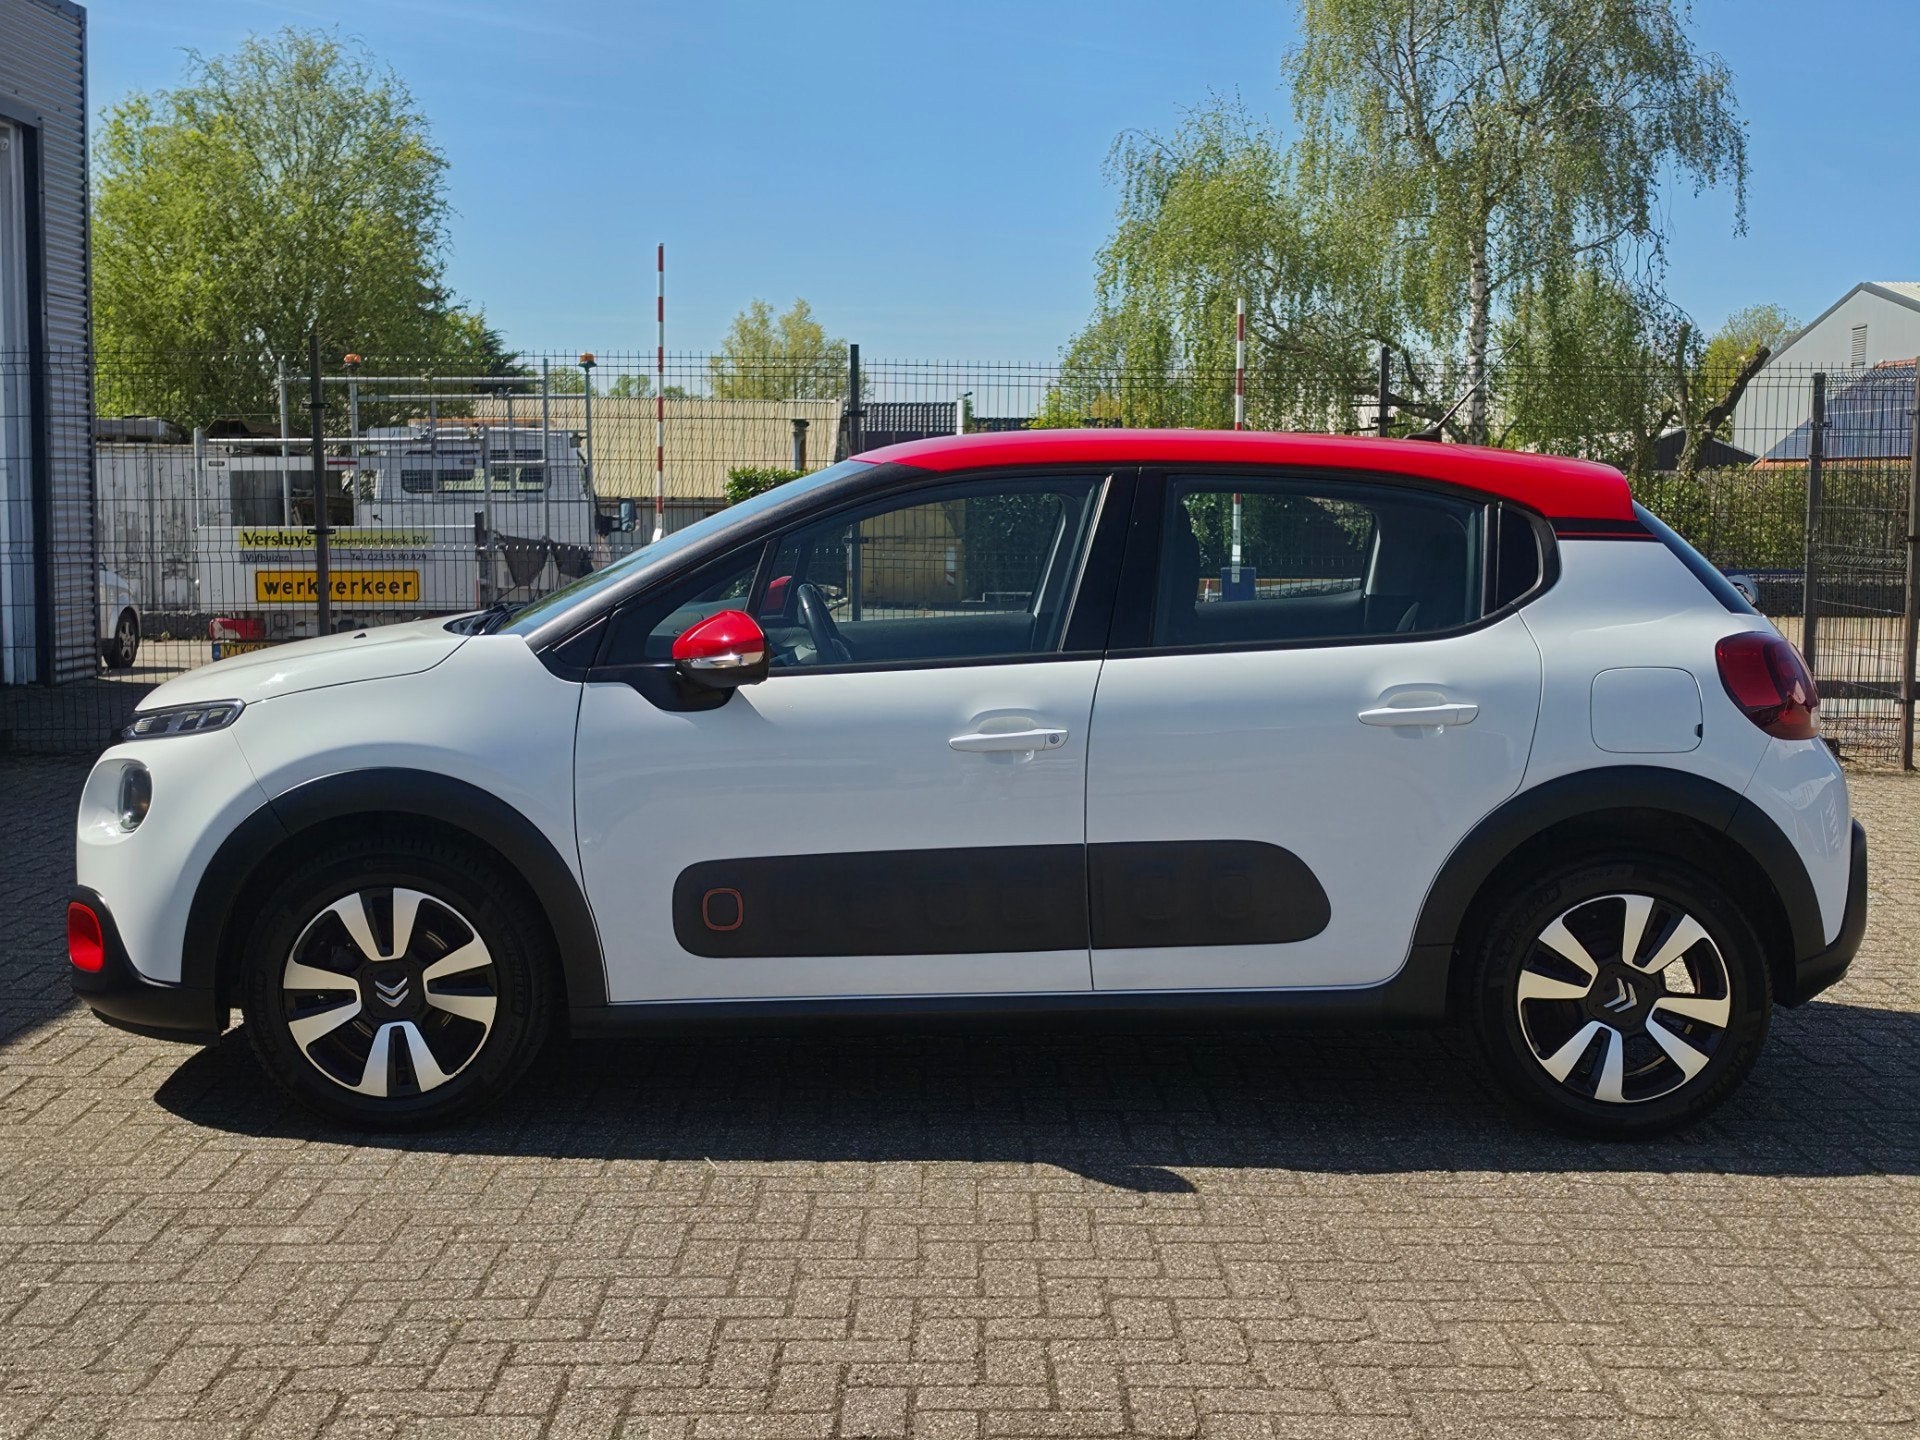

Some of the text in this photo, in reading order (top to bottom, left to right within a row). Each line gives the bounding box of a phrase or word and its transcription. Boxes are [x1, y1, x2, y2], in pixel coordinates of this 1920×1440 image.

[244, 531, 312, 548] Versluys
[412, 535, 428, 545] BV
[246, 553, 290, 563] Vijfhuizen
[263, 577, 412, 595] werkerkeer
